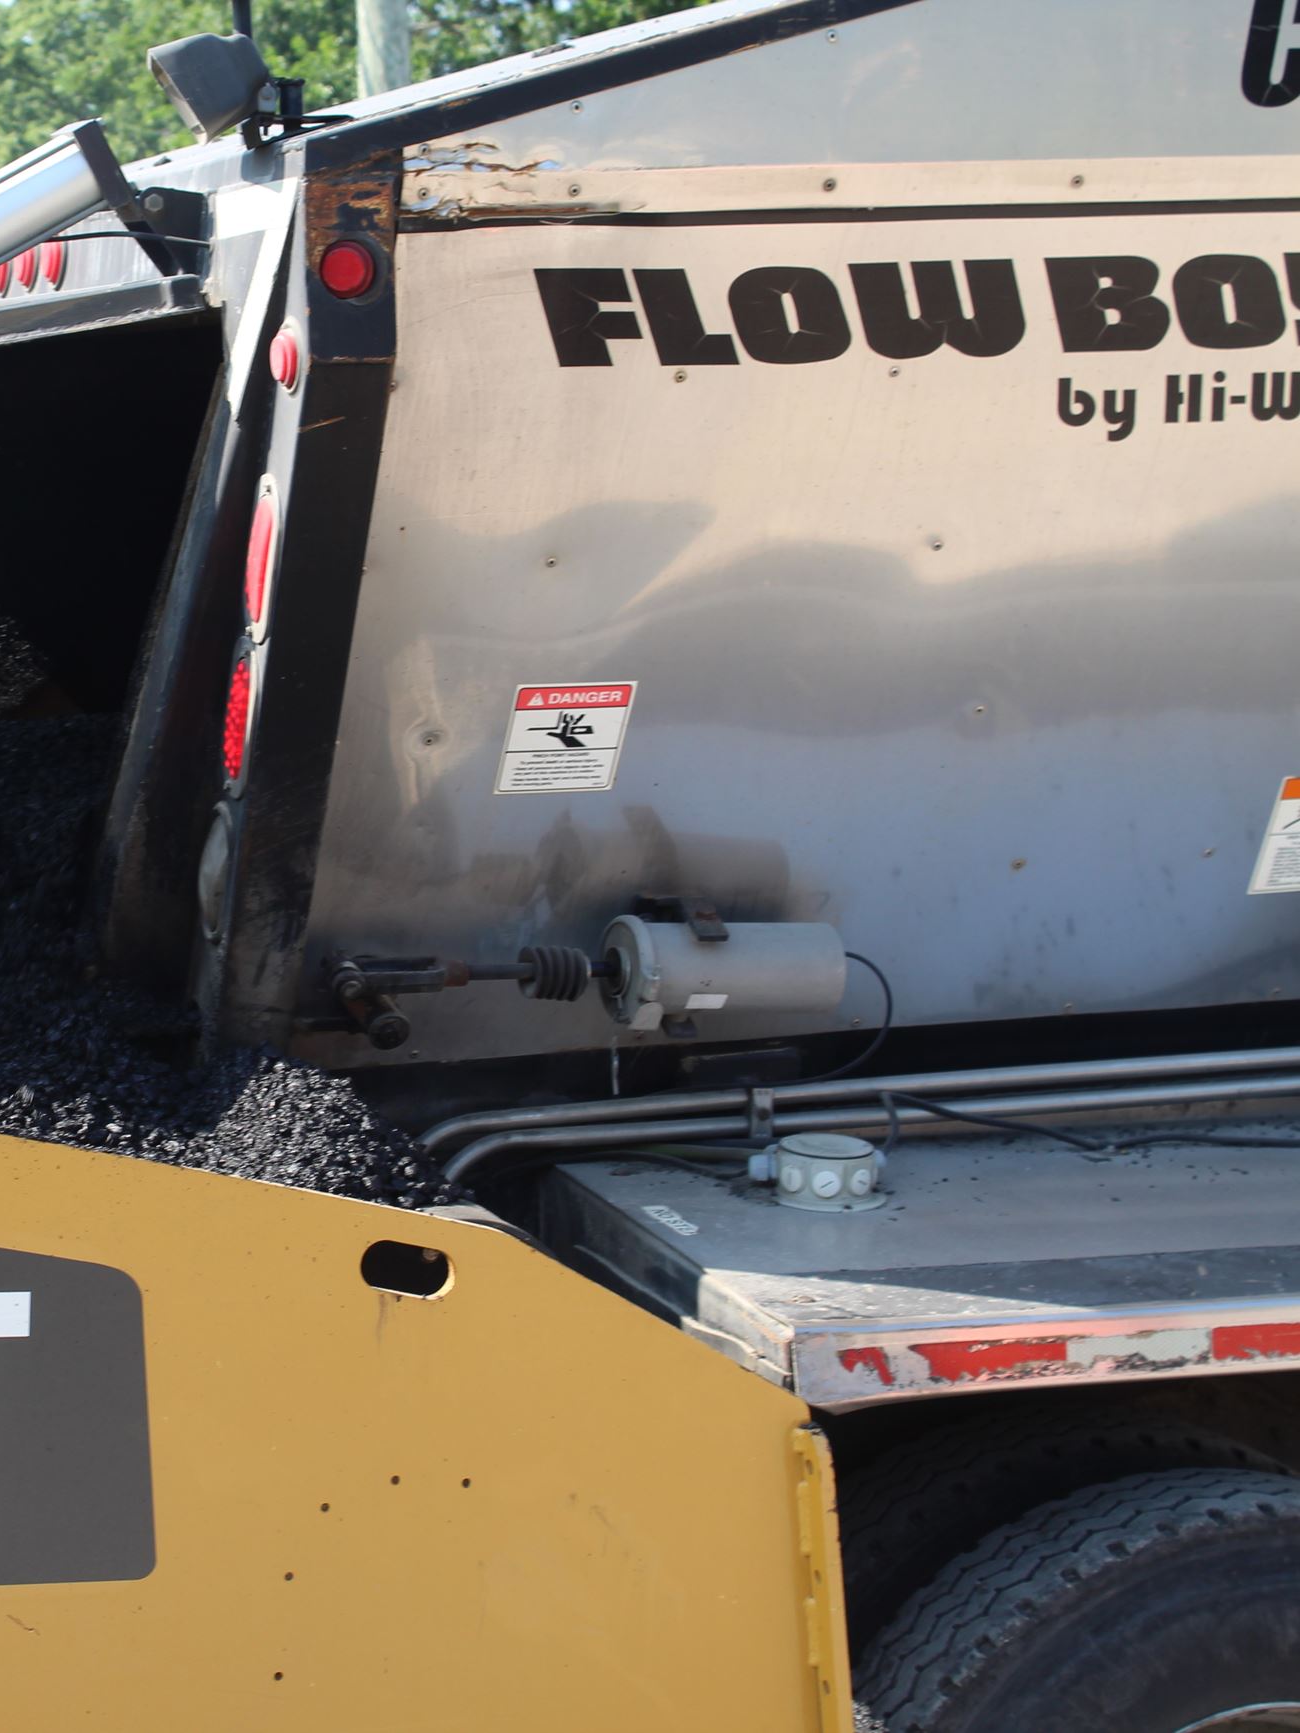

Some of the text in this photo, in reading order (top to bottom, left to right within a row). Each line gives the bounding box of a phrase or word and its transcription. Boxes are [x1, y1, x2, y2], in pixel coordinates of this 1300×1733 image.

[533, 258, 1026, 367] FLOW
[1058, 377, 1138, 442] by
[547, 690, 623, 704] DANGER
